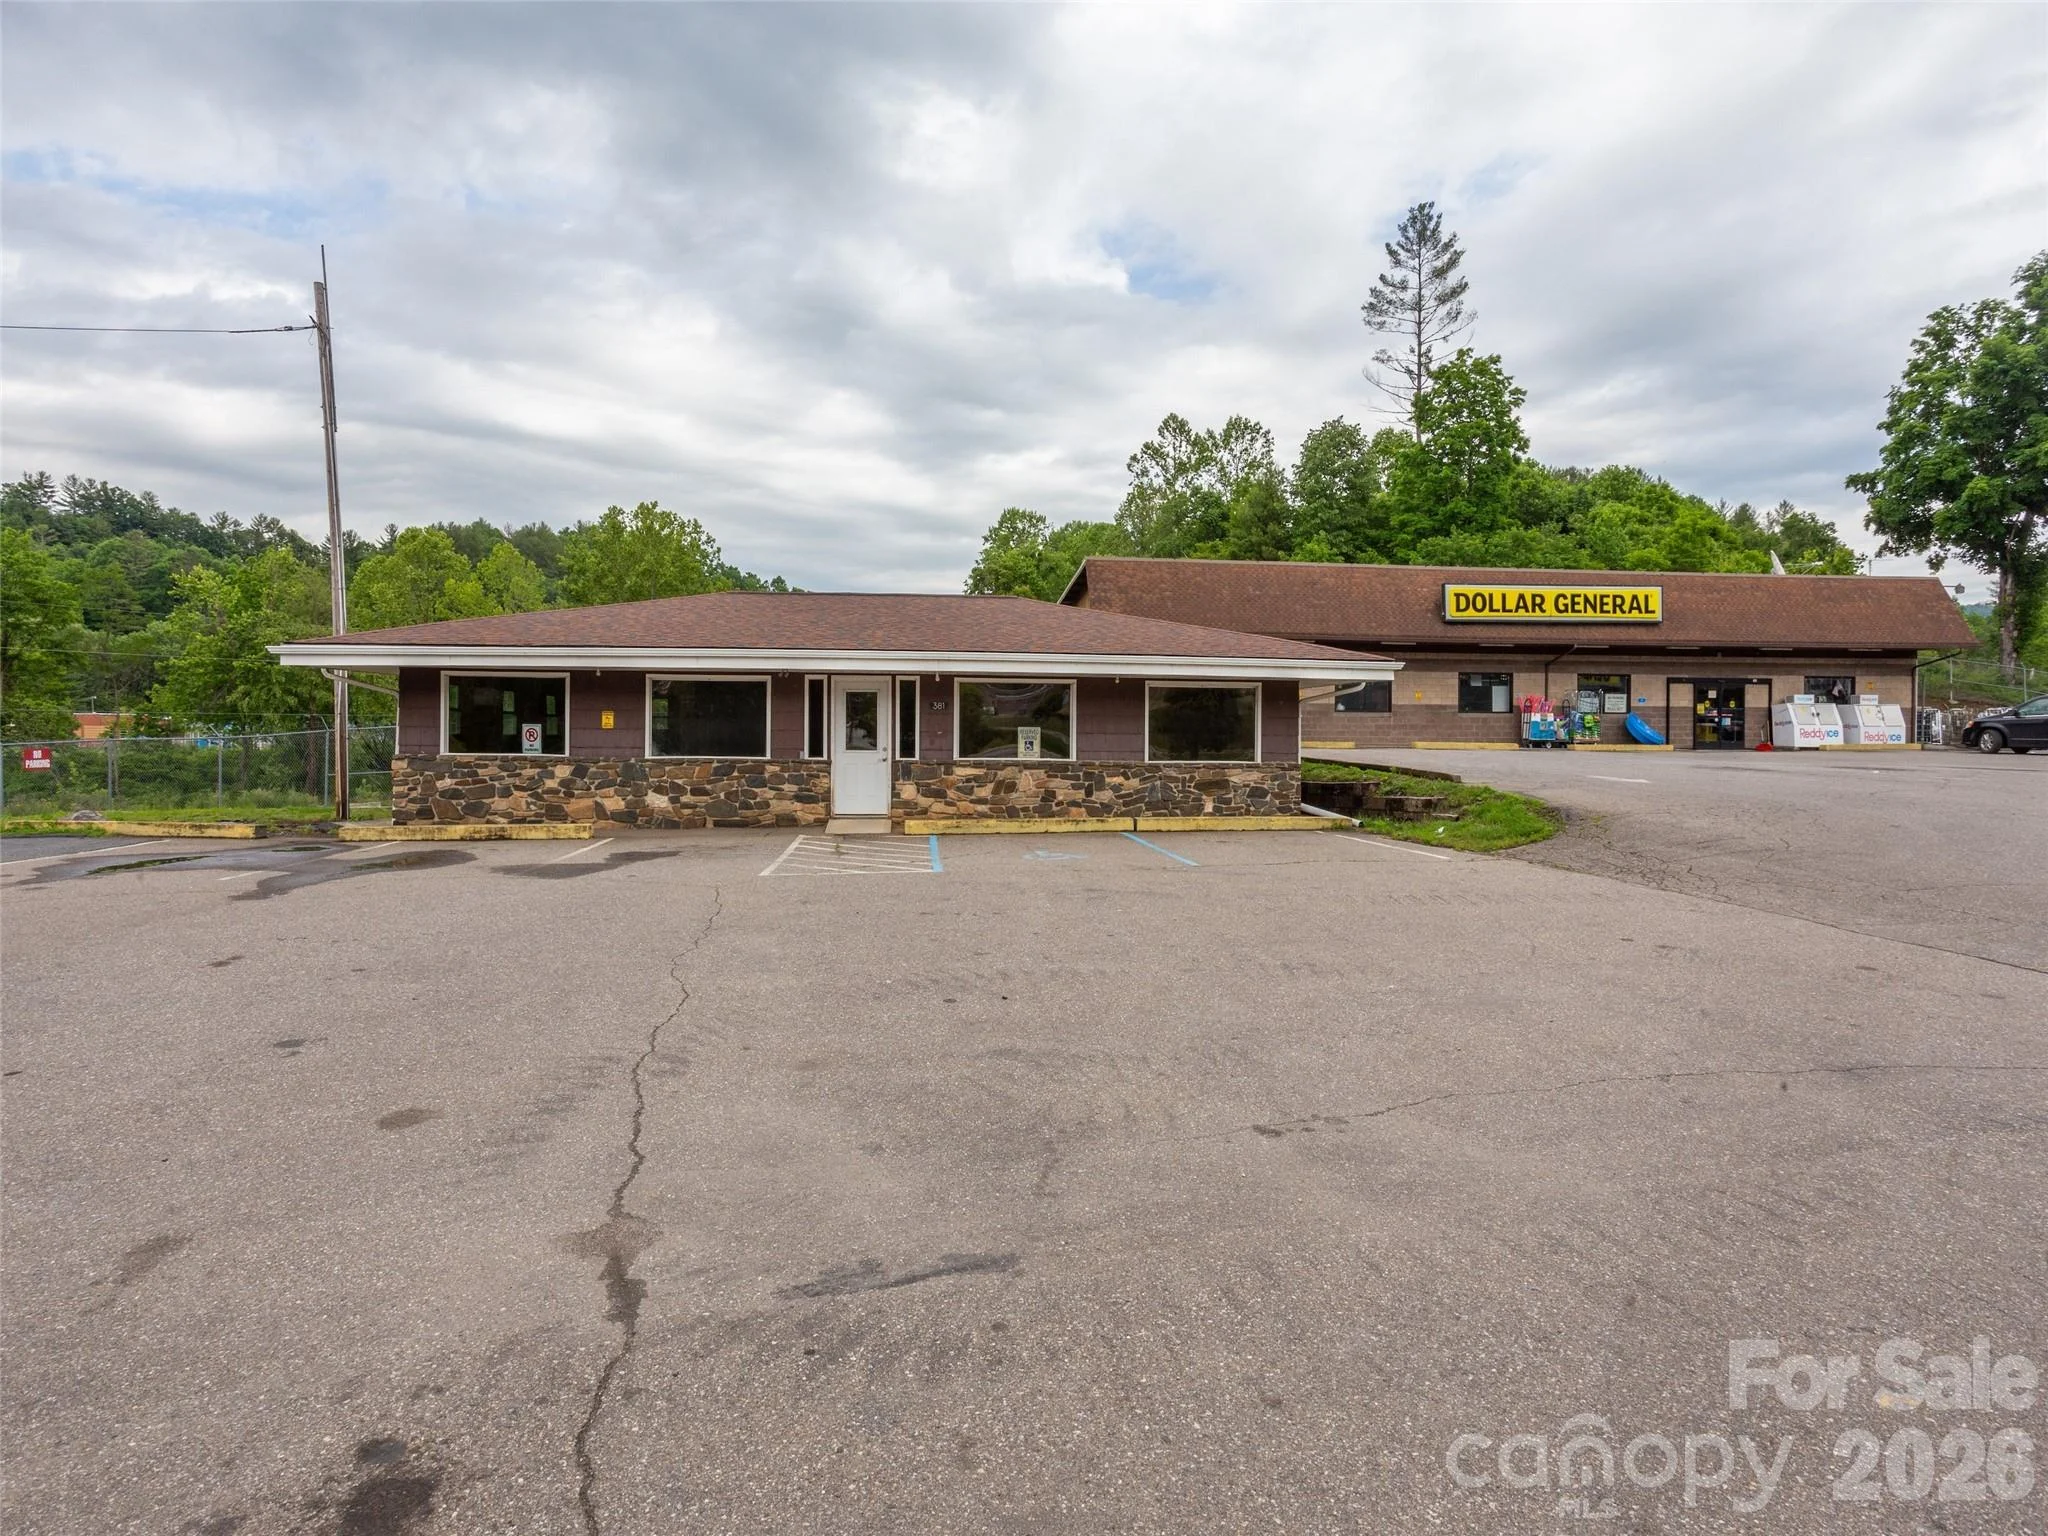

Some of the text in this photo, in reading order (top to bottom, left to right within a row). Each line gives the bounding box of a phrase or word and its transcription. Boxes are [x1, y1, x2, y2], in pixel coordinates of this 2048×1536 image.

[1453, 592, 1656, 615] DOLLAR GENERAL
[932, 701, 945, 710] 381
[33, 750, 42, 758] NO
[25, 759, 50, 768] PARKING
